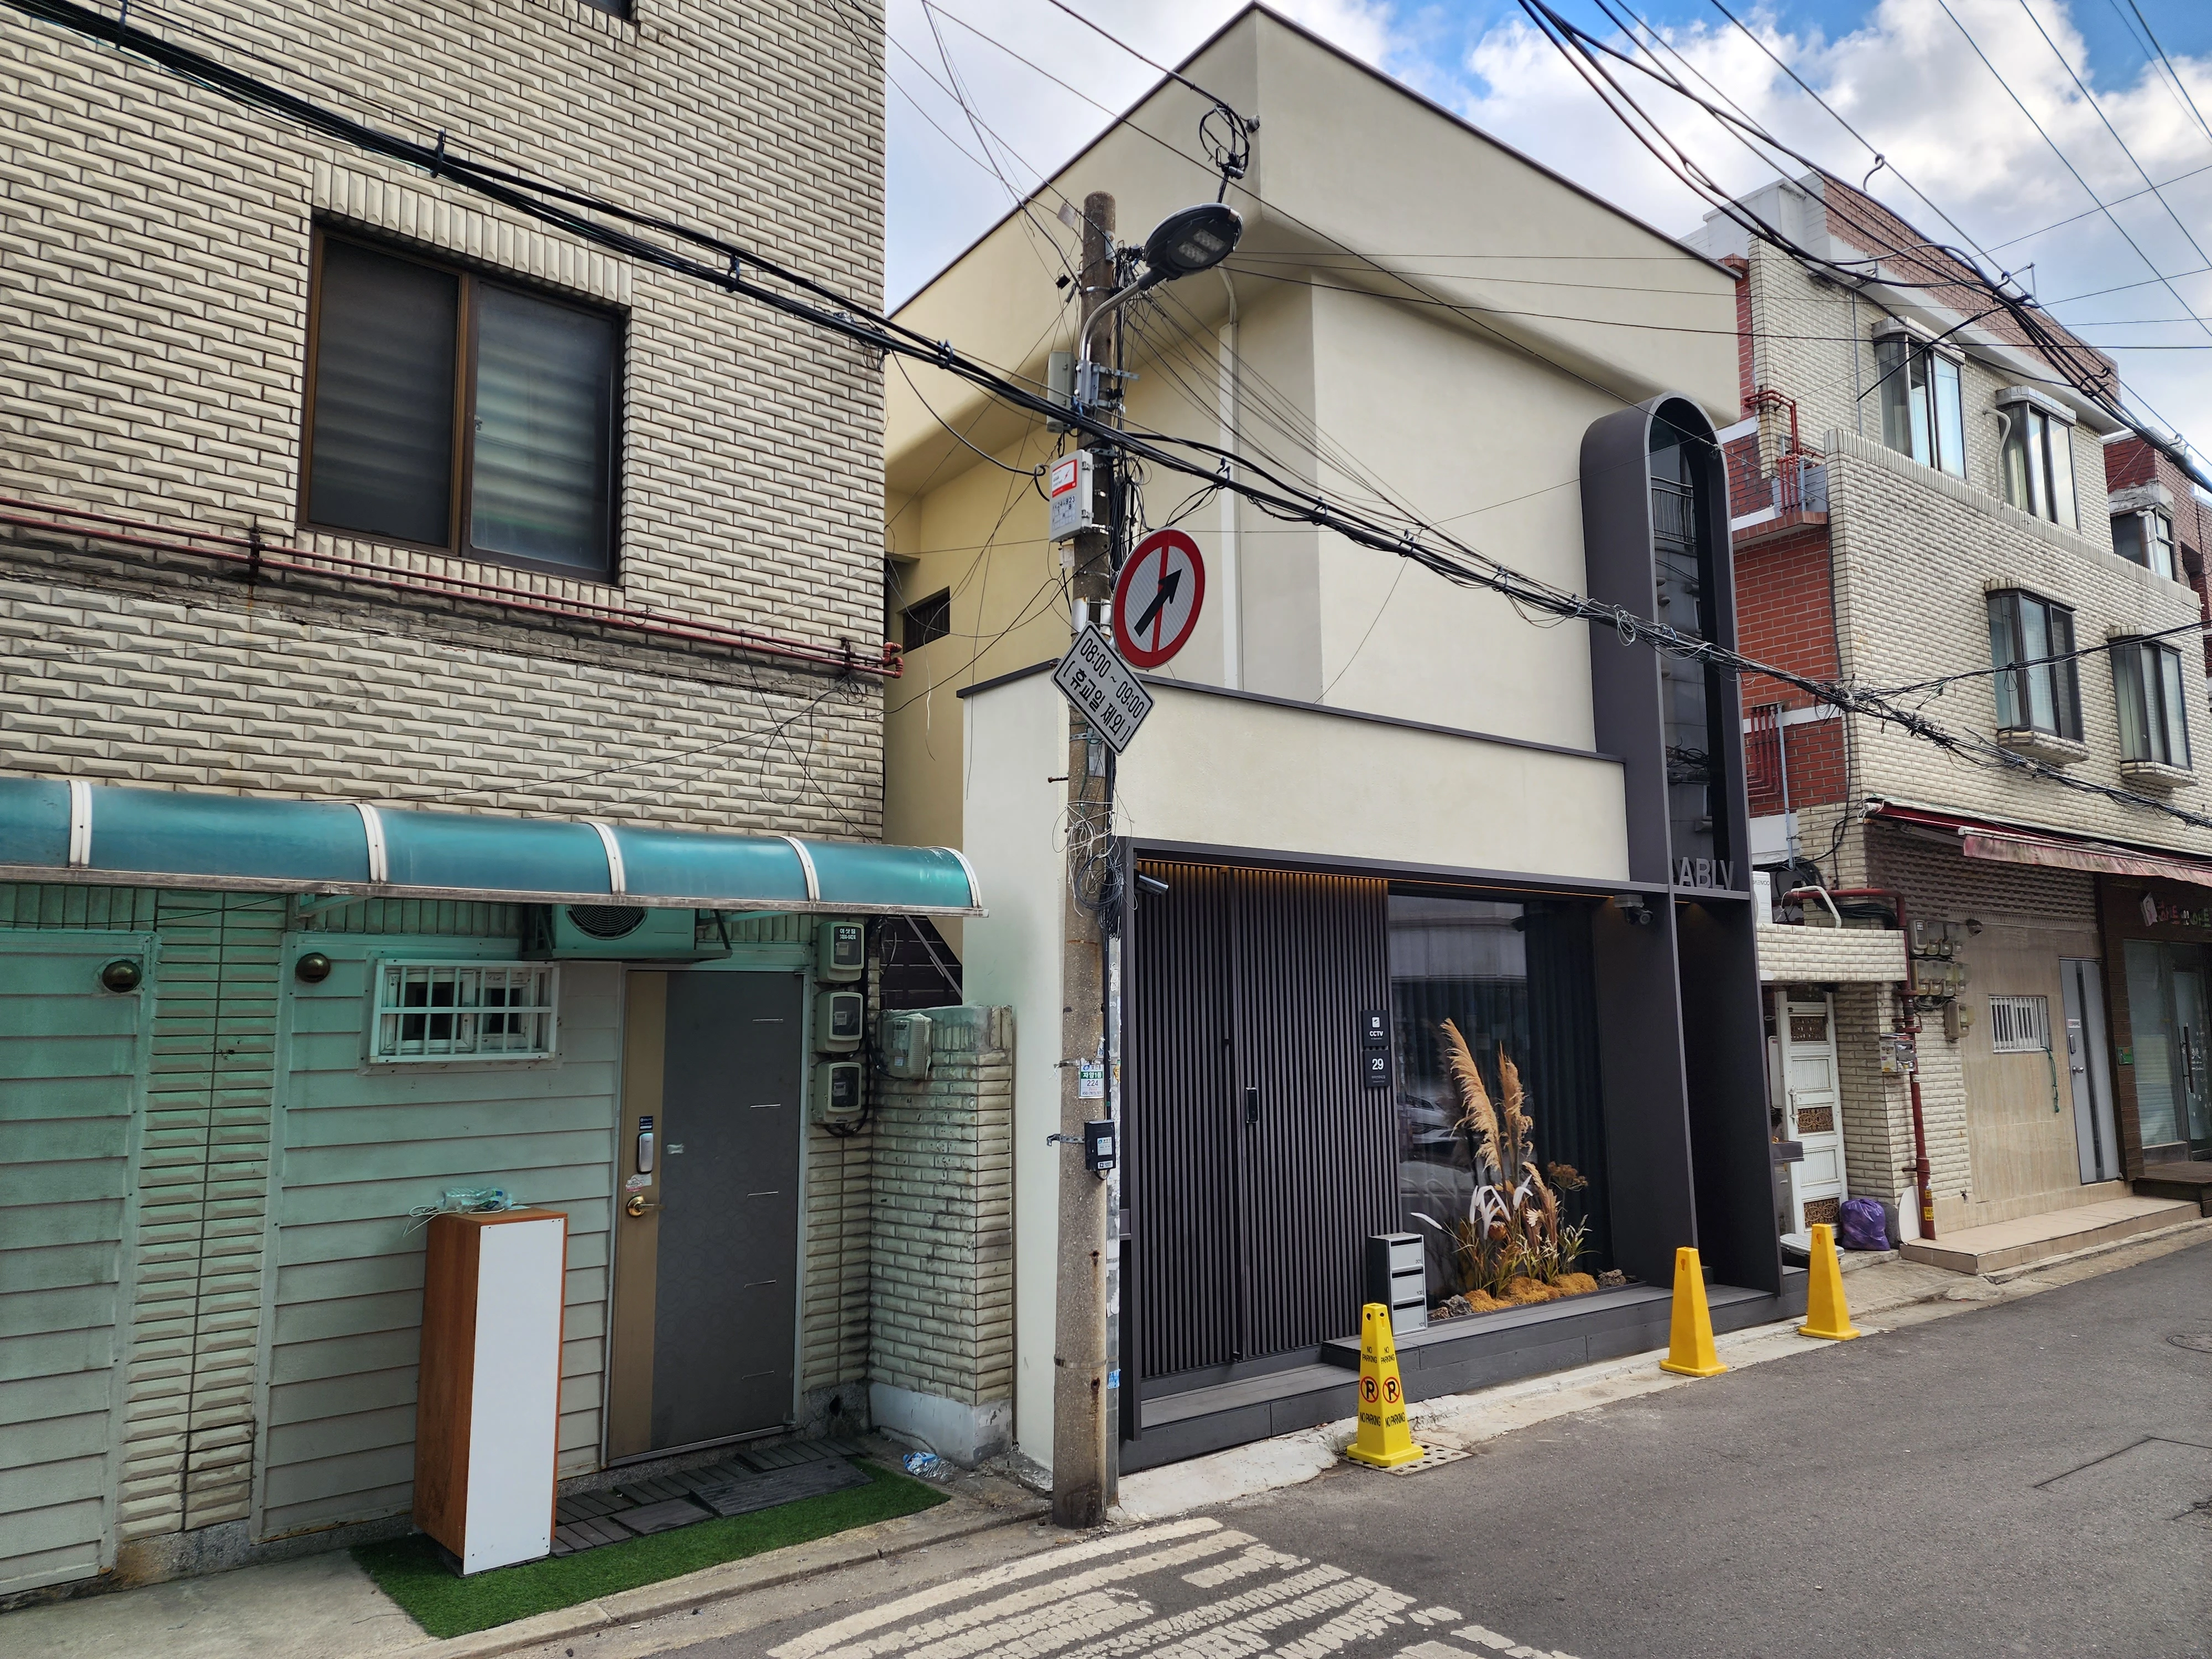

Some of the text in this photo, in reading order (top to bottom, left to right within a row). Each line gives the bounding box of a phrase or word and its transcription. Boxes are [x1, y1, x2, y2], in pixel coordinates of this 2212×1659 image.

[1081, 638, 1111, 678] 08:00
[1115, 681, 1145, 718] 09:00
[1678, 857, 1734, 890] ABLV
[1372, 1058, 1384, 1070] 29
[1367, 1345, 1372, 1354] NO
[1362, 1354, 1378, 1364] PARKING
[1380, 1354, 1395, 1364] PARKING
[1366, 1380, 1375, 1399] P
[1387, 1381, 1396, 1401] P
[1360, 1412, 1381, 1427] NO PARKING
[1385, 1412, 1405, 1428] NO PARKING
